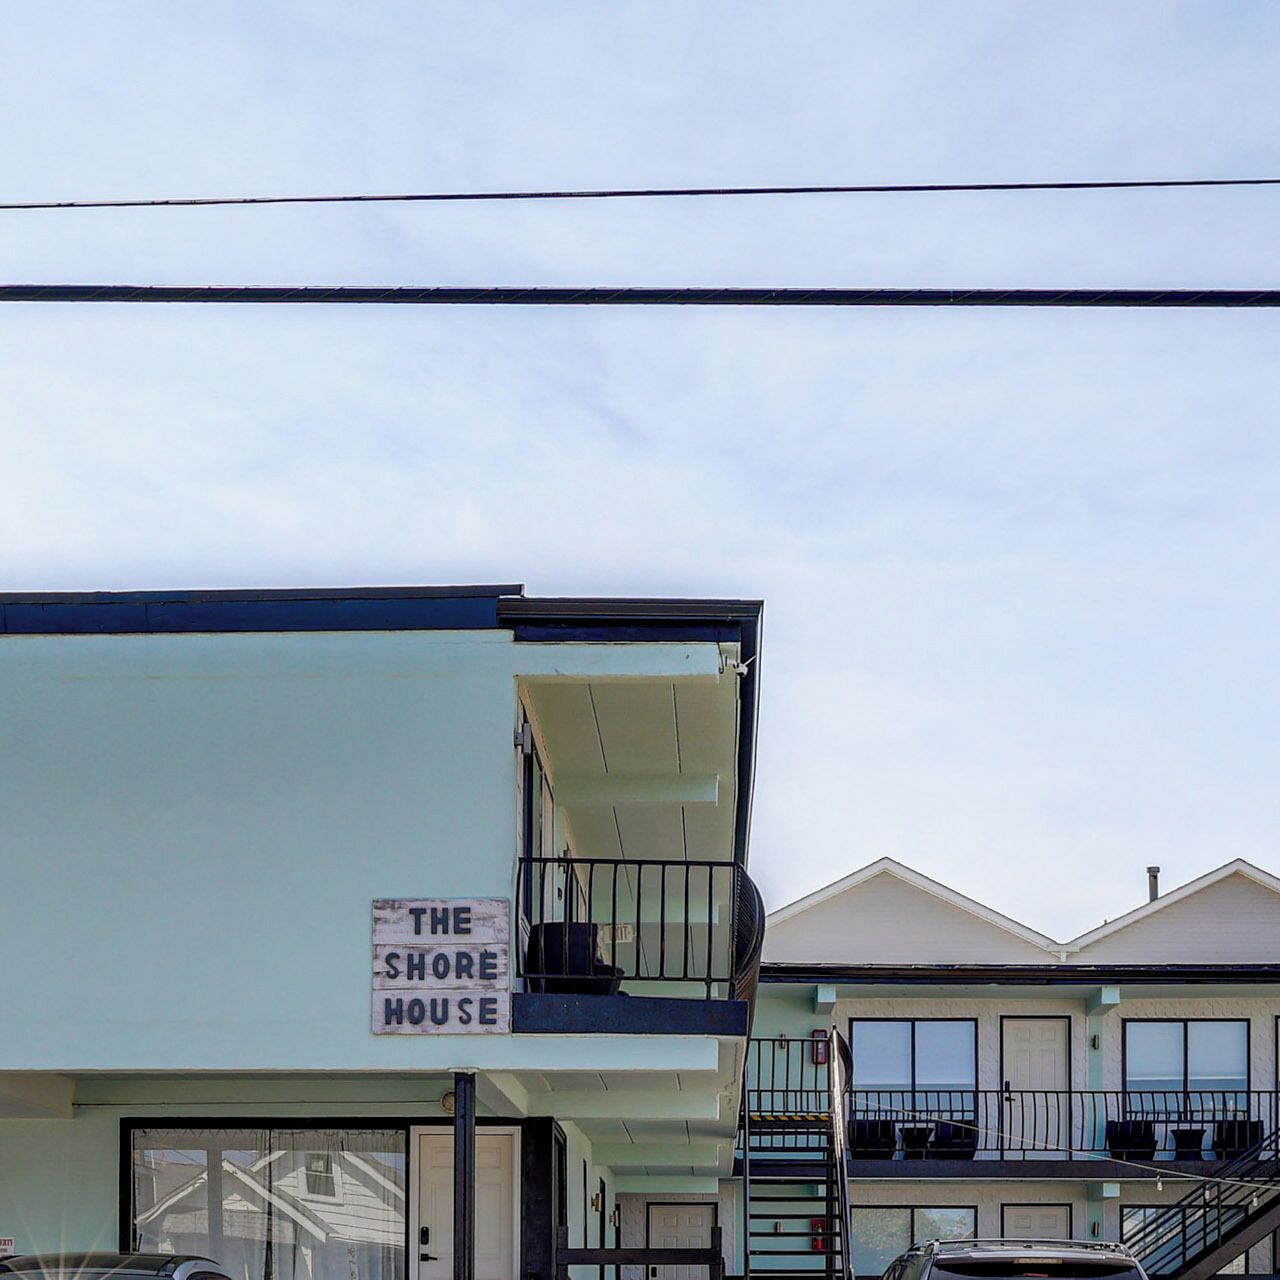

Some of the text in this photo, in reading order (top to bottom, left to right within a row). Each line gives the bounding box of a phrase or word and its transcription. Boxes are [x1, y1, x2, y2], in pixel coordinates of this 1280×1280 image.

[408, 906, 471, 935] THE
[384, 952, 498, 980] SHORE
[384, 997, 498, 1025] HOUSE
